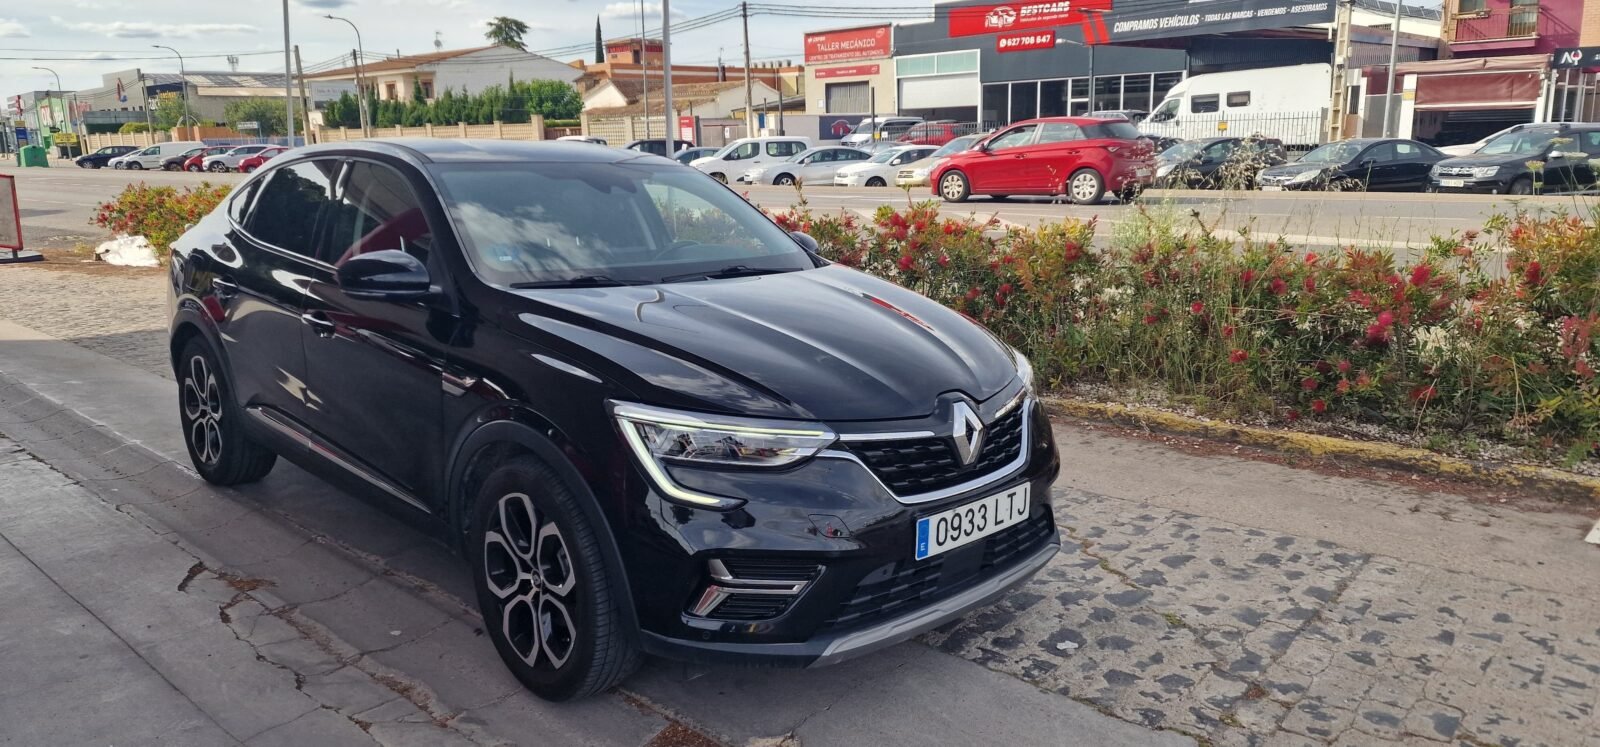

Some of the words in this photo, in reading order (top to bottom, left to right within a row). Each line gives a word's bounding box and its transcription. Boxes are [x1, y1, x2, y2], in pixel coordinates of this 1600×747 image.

[1020, 1, 1071, 17] BESTCARS
[1113, 18, 1159, 33] COMPRAMOS
[1159, 14, 1200, 28] VEHÍCULOS
[1204, 13, 1221, 22] TODAS
[1221, 12, 1232, 20] LAS
[1232, 10, 1254, 19] MARCAS
[1257, 7, 1287, 17] VENDEMOS
[1290, 3, 1329, 13] ASESORAMOS
[817, 42, 839, 51] TALLER
[841, 38, 876, 49] MECÁNICO
[1007, 37, 1021, 47] 627
[1021, 35, 1035, 45] 708
[936, 503, 988, 546] 0933
[994, 487, 1028, 526] LTJ
